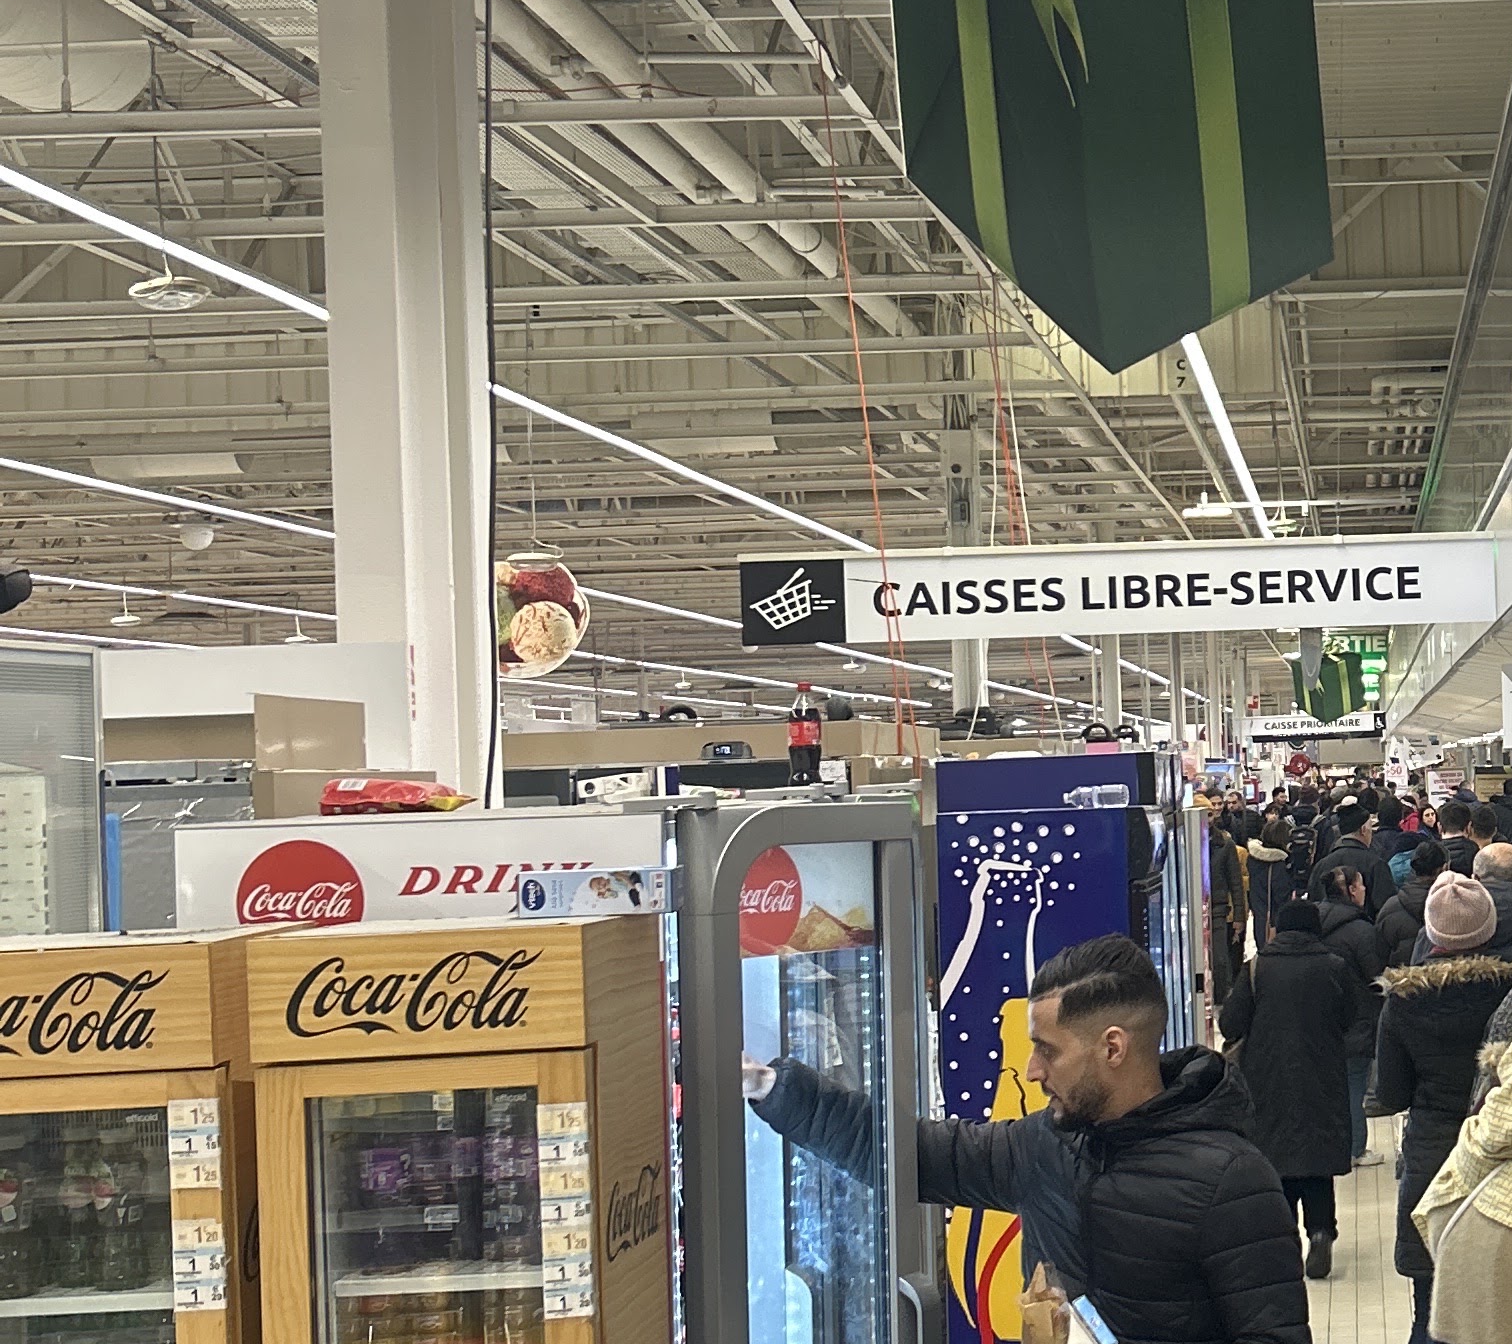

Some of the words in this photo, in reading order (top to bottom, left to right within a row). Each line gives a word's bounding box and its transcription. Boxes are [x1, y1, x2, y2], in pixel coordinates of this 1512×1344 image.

[873, 576, 1065, 617] CAISSES
[1080, 565, 1422, 611] LIBRE-SERVICE
[1264, 721, 1299, 731] CAISSE
[243, 881, 359, 920] Coca-Cola
[0, 968, 171, 1057] a-Cola
[286, 949, 544, 1037] Coca-Cola
